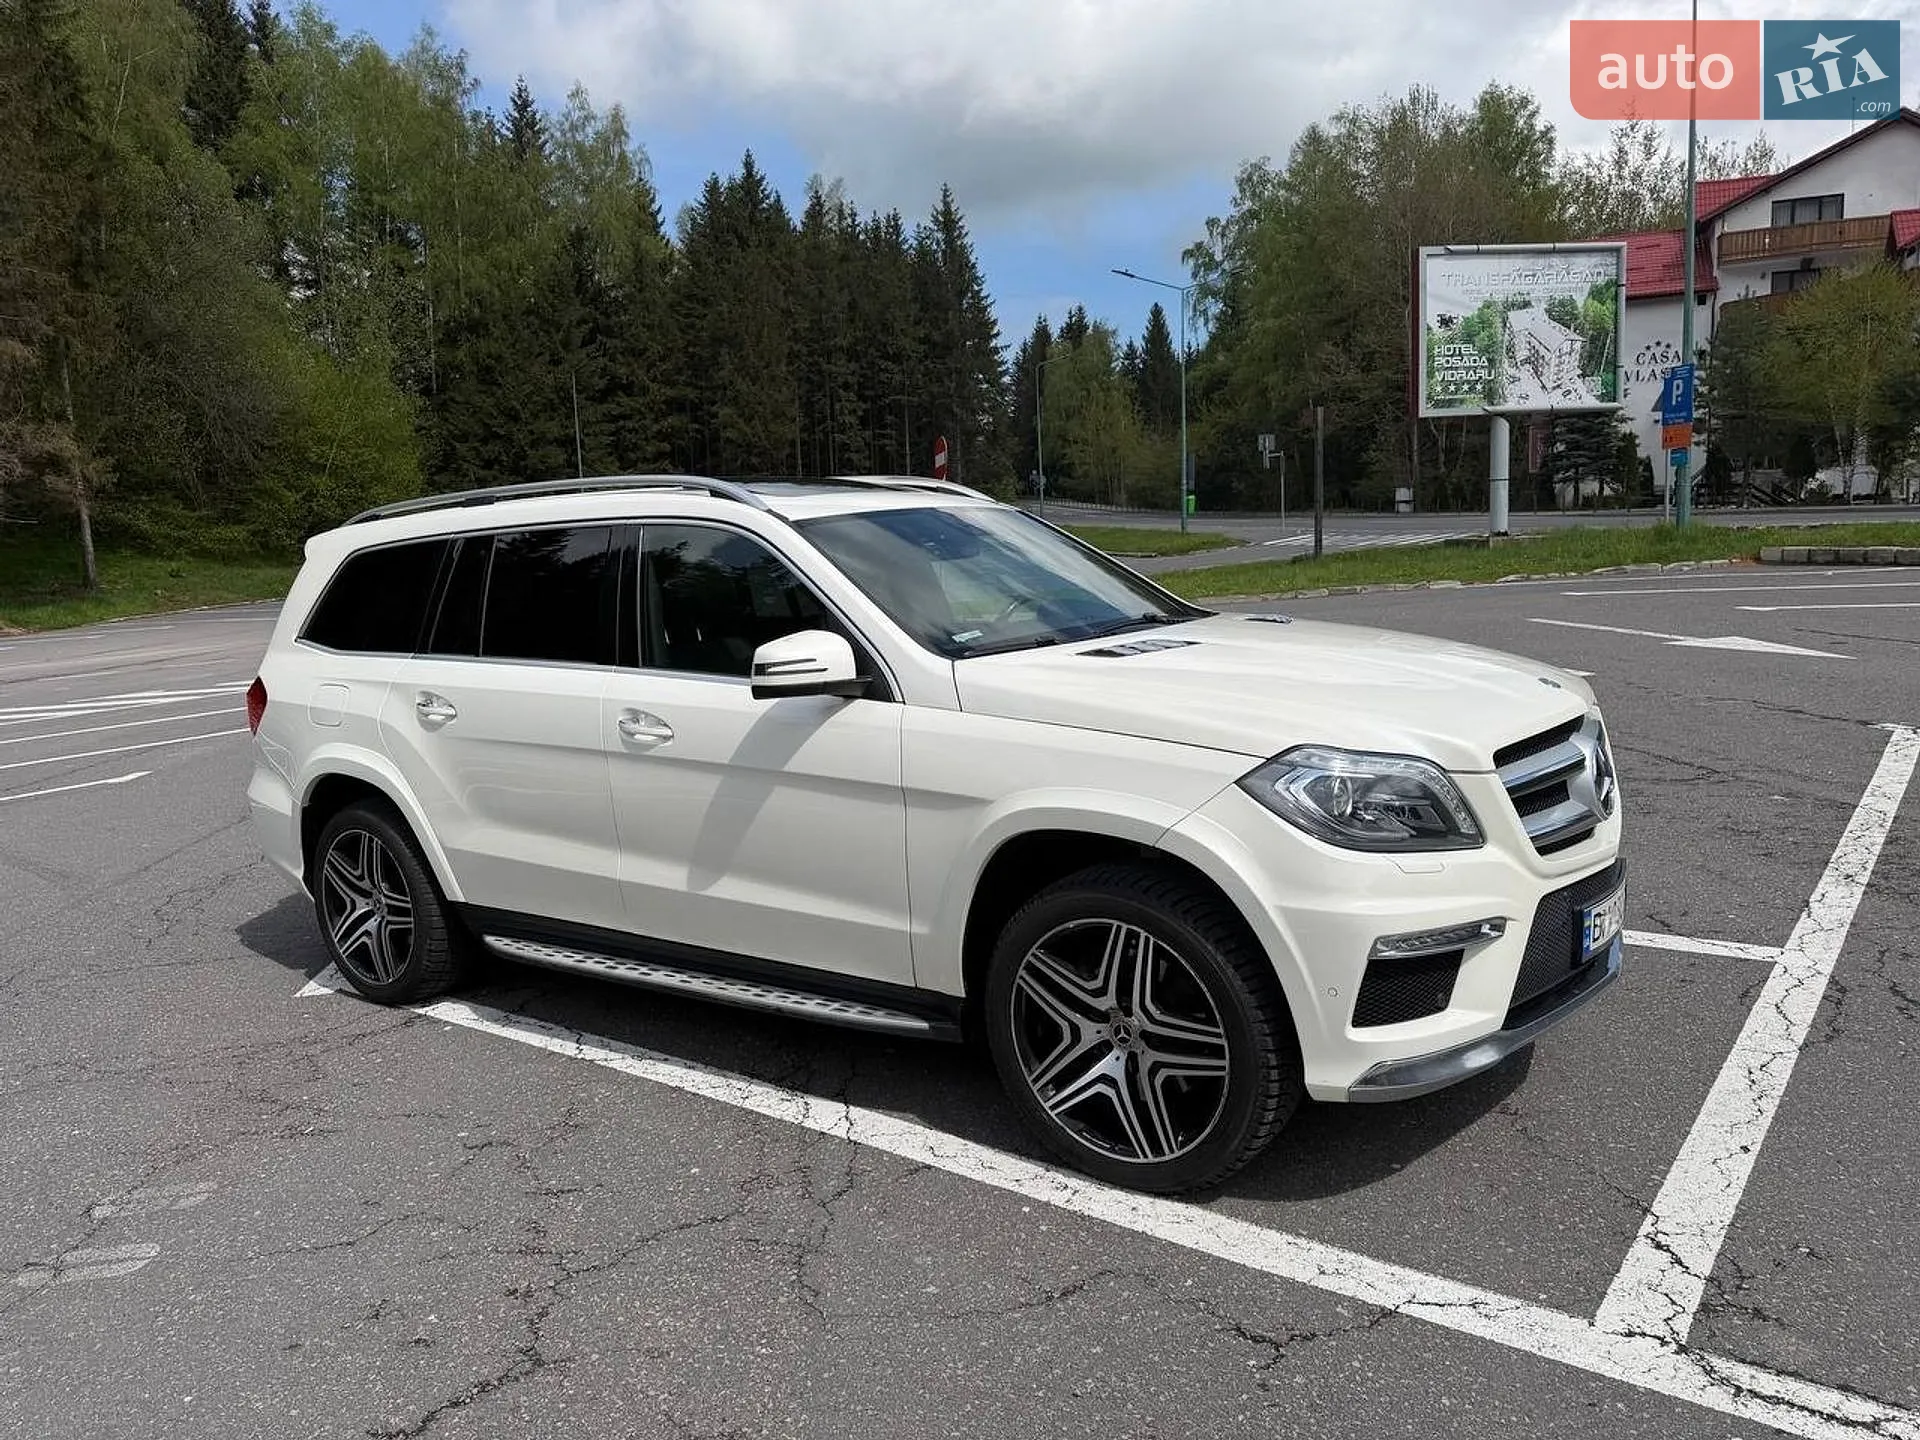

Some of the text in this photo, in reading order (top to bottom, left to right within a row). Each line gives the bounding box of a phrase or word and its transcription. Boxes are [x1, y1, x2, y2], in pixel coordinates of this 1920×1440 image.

[1434, 343, 1479, 355] HOTEL
[1434, 356, 1489, 368] POSADA
[1635, 350, 1682, 366] CASA
[1434, 369, 1495, 382] VIDRARU
